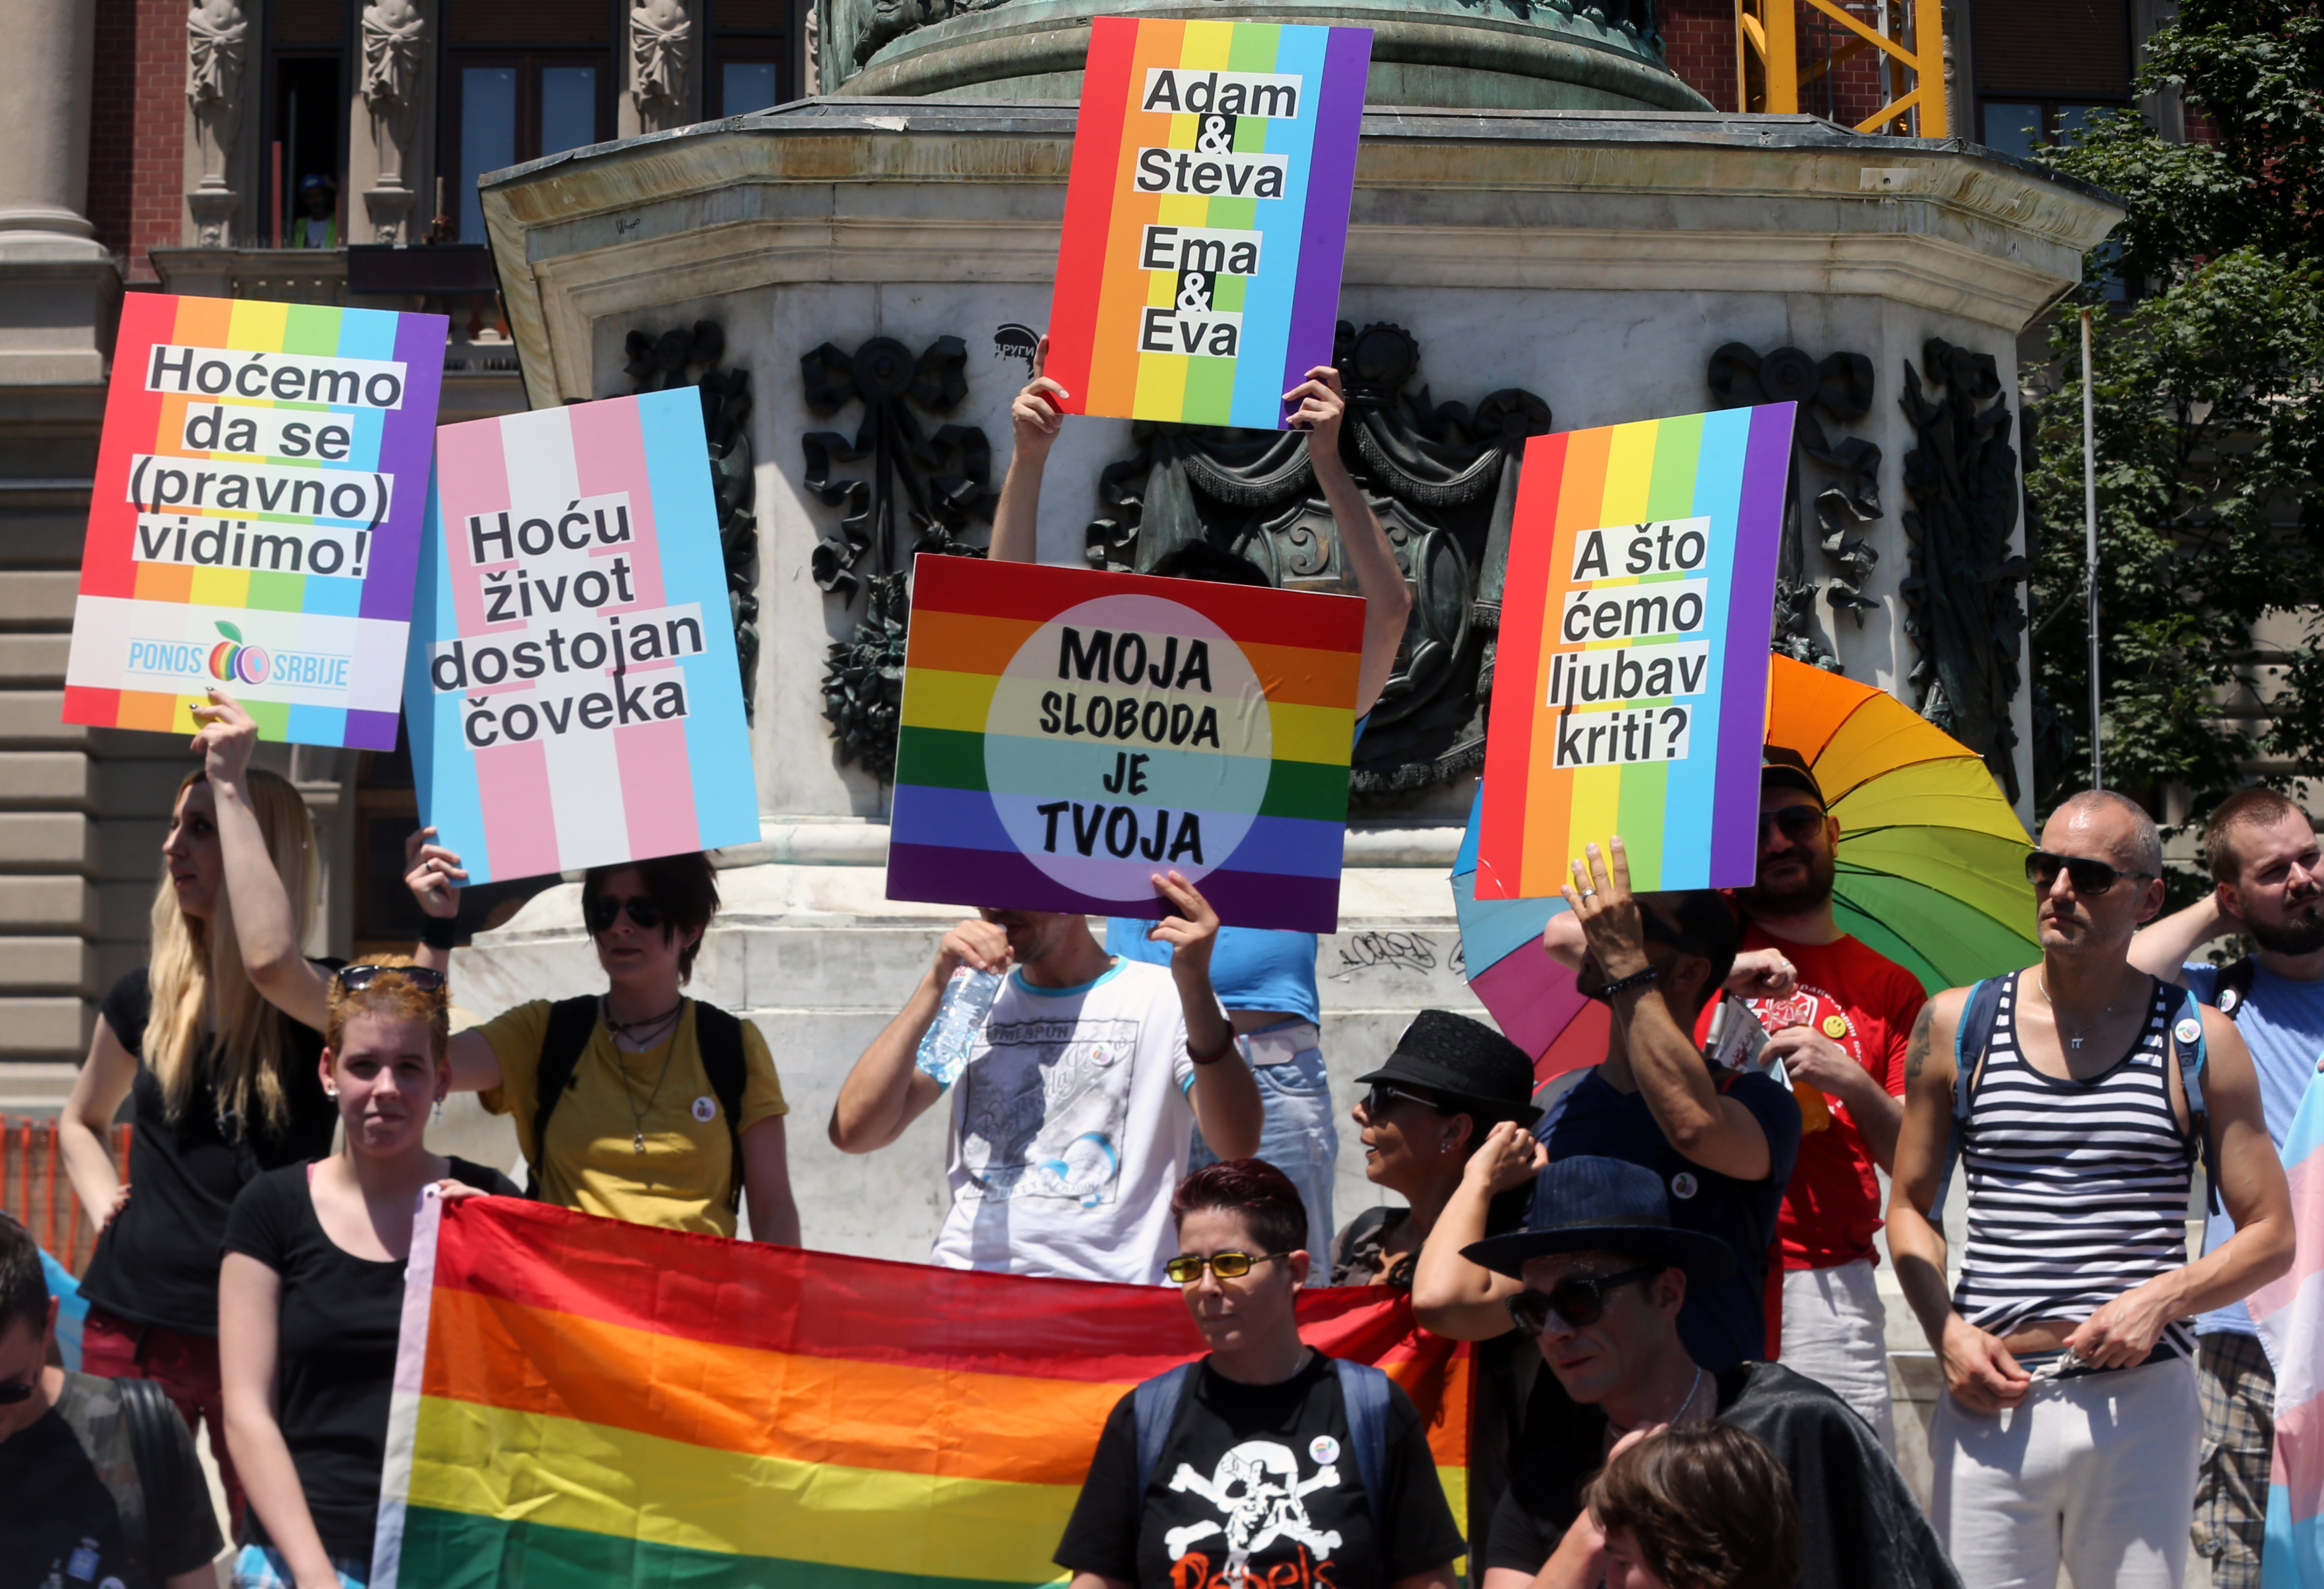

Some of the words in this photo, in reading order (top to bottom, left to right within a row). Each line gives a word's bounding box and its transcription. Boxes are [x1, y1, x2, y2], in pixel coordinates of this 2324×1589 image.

[1143, 70, 1296, 117] Adam
[1197, 116, 1232, 155] &
[1137, 148, 1284, 198] Steva
[1143, 226, 1257, 274] Ema
[1177, 272, 1211, 312] &
[1142, 308, 1238, 356] Eva
[149, 346, 401, 407] Hoćemo
[185, 406, 256, 452] da
[279, 422, 351, 459] se
[131, 457, 388, 531] (pravno)
[138, 517, 367, 576] vidimo!
[470, 499, 630, 563] Hoću
[1573, 531, 1609, 580] A
[1625, 522, 1706, 575] što
[484, 557, 635, 622] život
[1564, 591, 1703, 641] ćemo
[129, 642, 203, 673] PONOS
[273, 654, 350, 686] SRBIJE
[431, 616, 703, 691] dostojan
[1058, 626, 1212, 693] MOJA
[464, 676, 688, 747] čoveka
[1550, 650, 1708, 717] ljubav
[1039, 691, 1220, 748] SLOBODA
[1556, 707, 1687, 766] kriti?
[1103, 751, 1150, 796] JE
[1036, 801, 1204, 865] TVOJA
